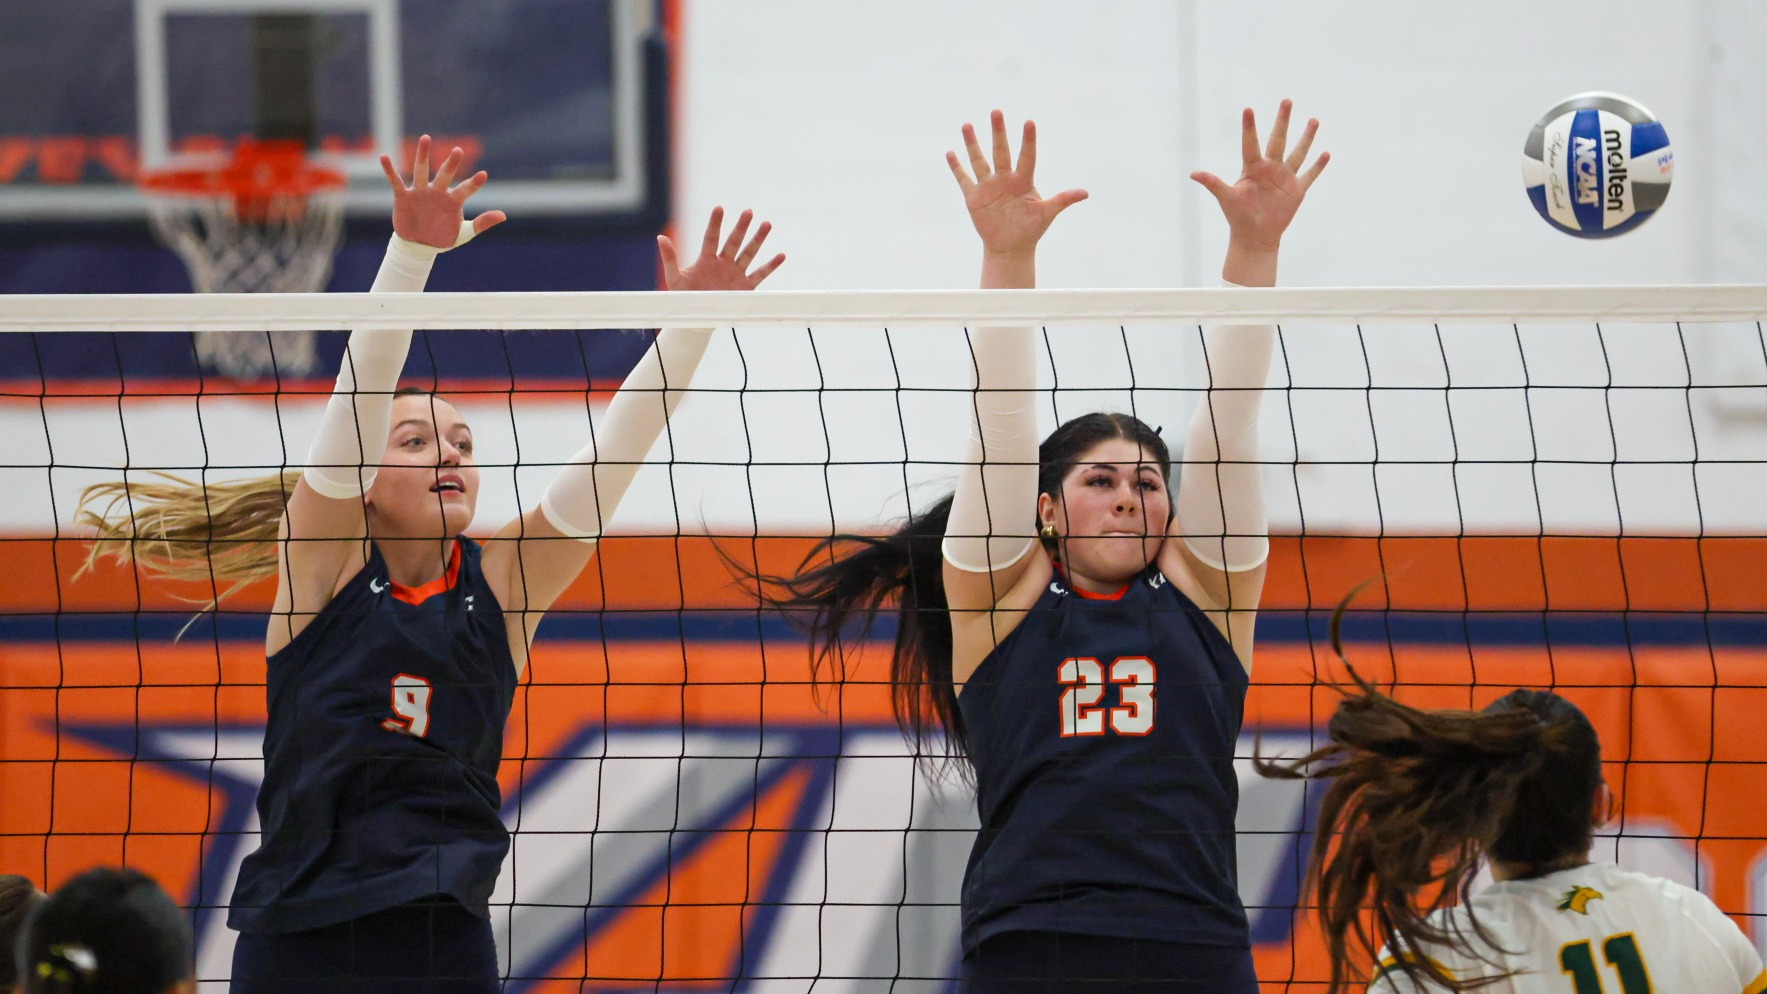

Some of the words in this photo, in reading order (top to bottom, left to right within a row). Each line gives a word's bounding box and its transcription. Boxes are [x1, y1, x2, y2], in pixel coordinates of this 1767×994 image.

[1575, 137, 1599, 205] NCAA
[1604, 130, 1627, 211] molten
[380, 672, 434, 738] 9
[1057, 655, 1158, 738] 23
